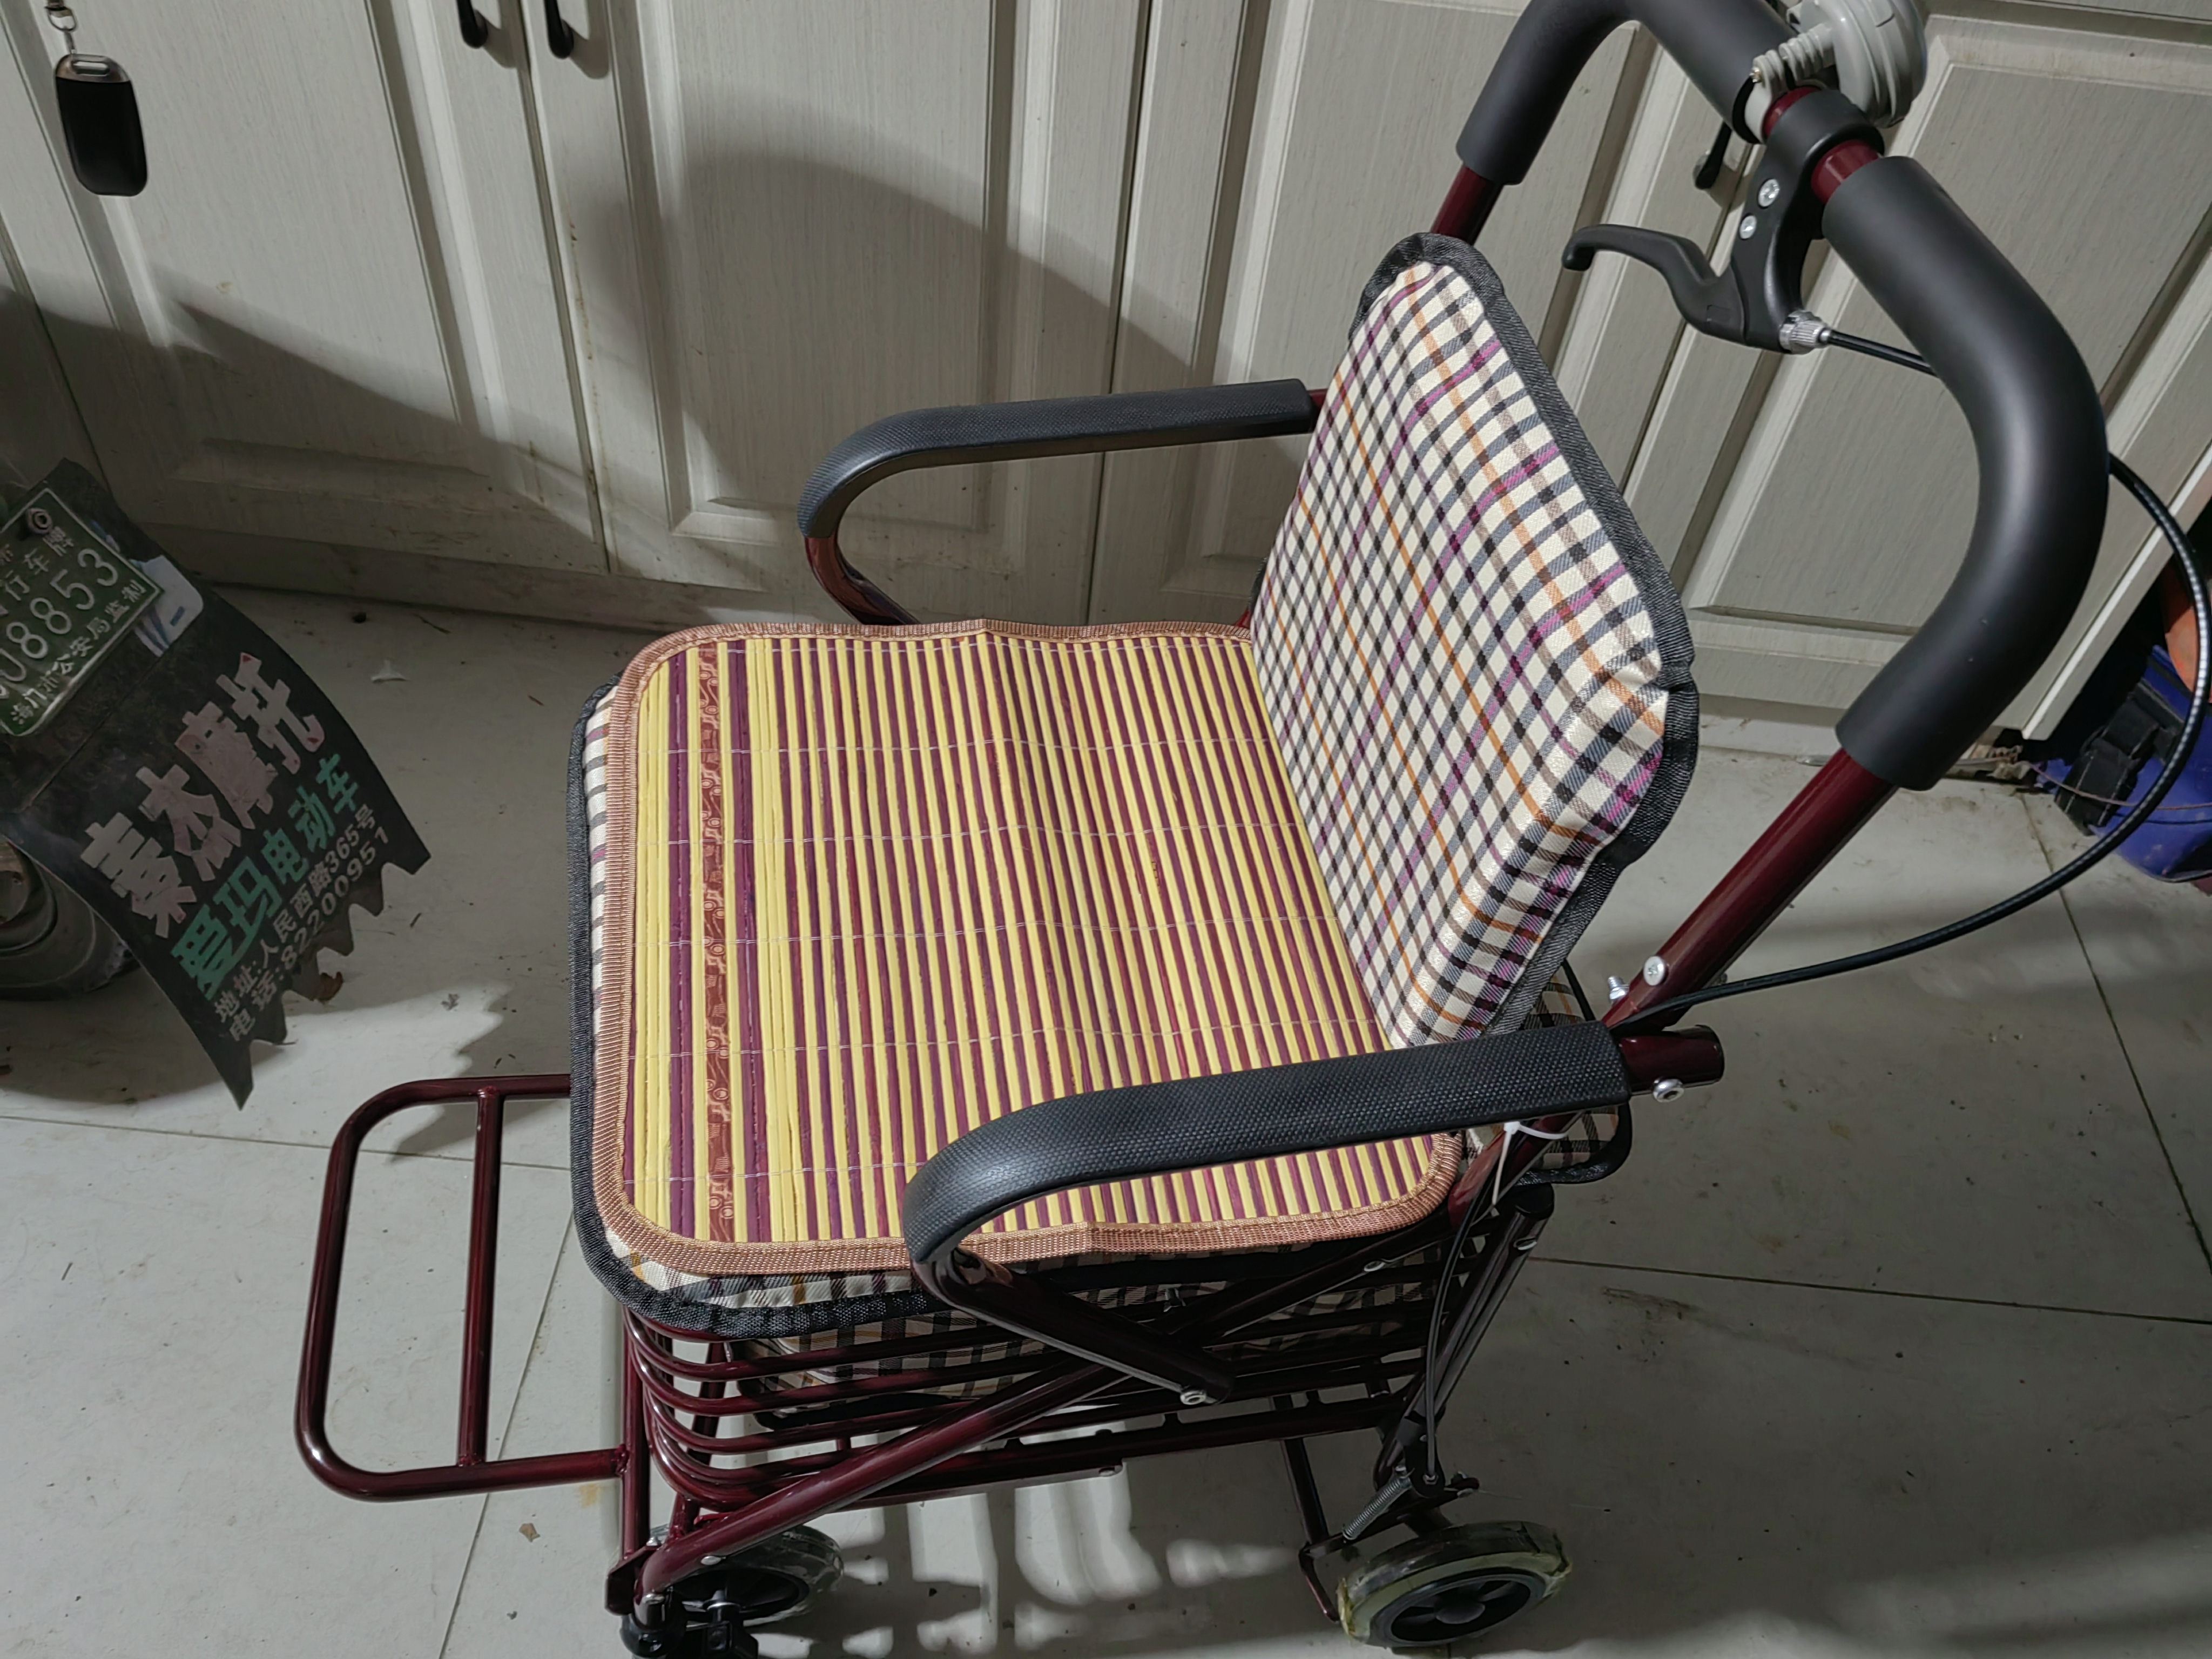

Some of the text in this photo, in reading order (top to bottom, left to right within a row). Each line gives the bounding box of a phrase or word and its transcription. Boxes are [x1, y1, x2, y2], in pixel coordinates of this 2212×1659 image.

[171, 753, 359, 1000] 爱玛电动车
